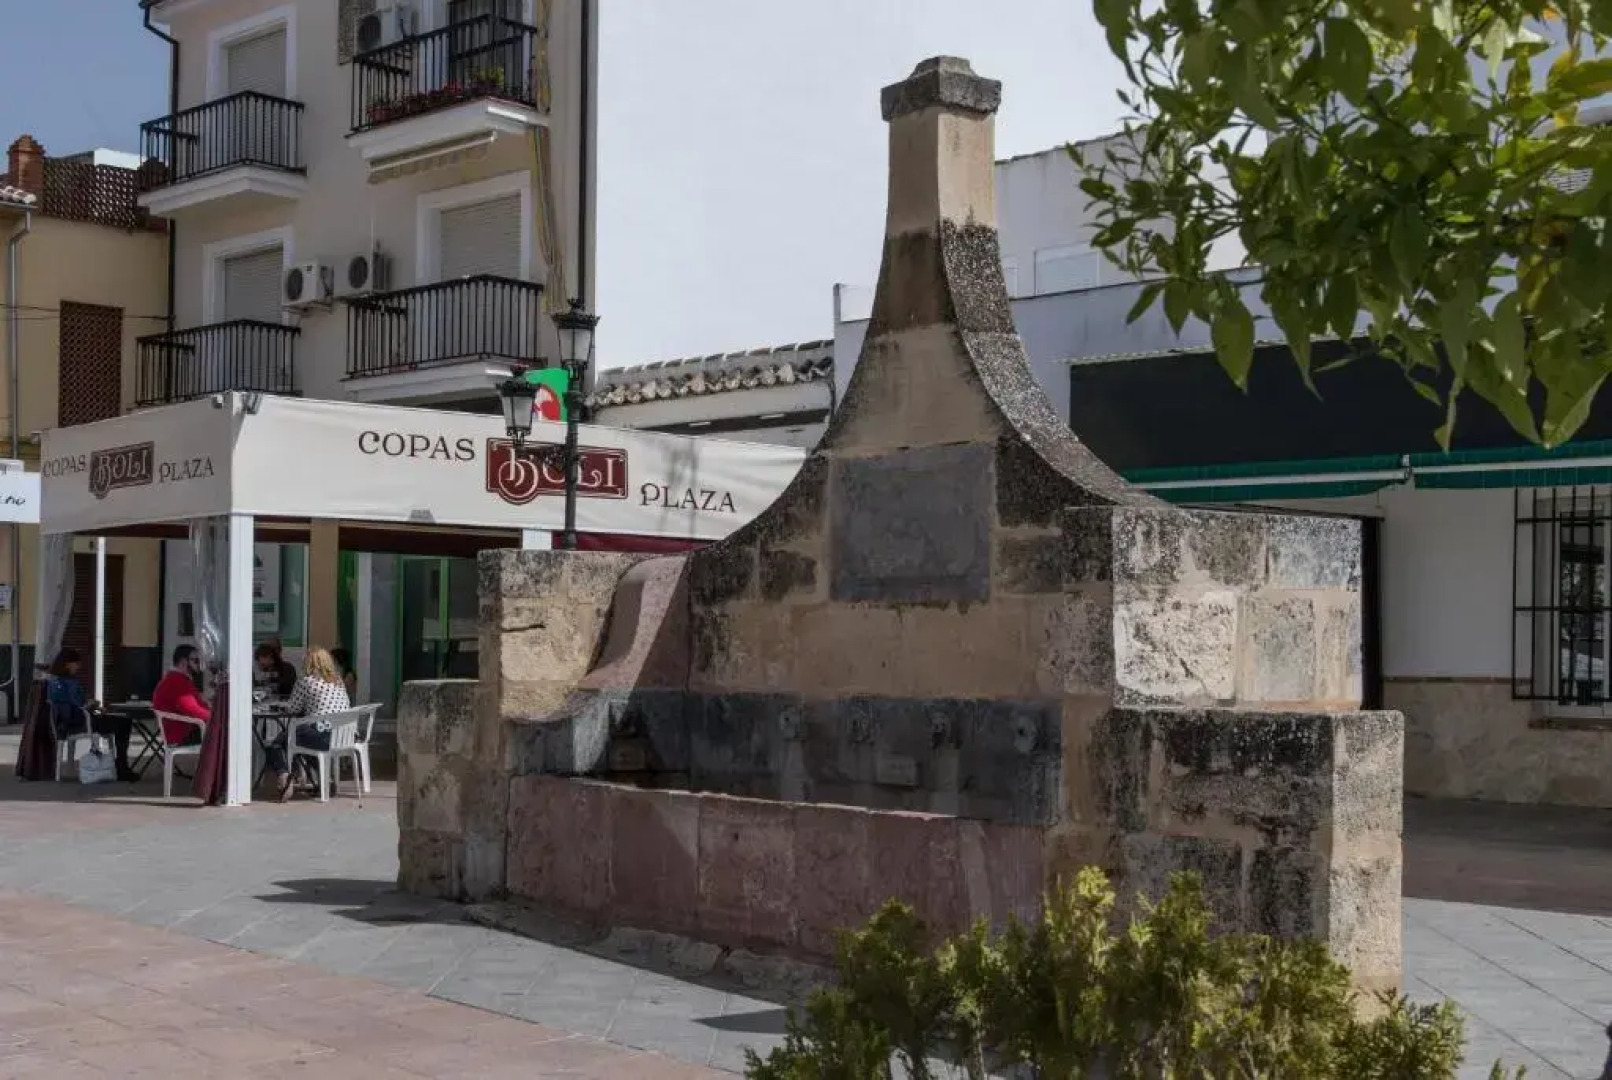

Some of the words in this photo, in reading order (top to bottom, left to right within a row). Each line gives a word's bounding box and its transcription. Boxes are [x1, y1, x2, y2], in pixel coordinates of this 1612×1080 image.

[43, 455, 86, 477] COPAS
[93, 450, 148, 494] BOLI
[158, 457, 215, 483] PLAZA
[358, 430, 475, 461] COPAS
[639, 482, 736, 513] PLAZA
